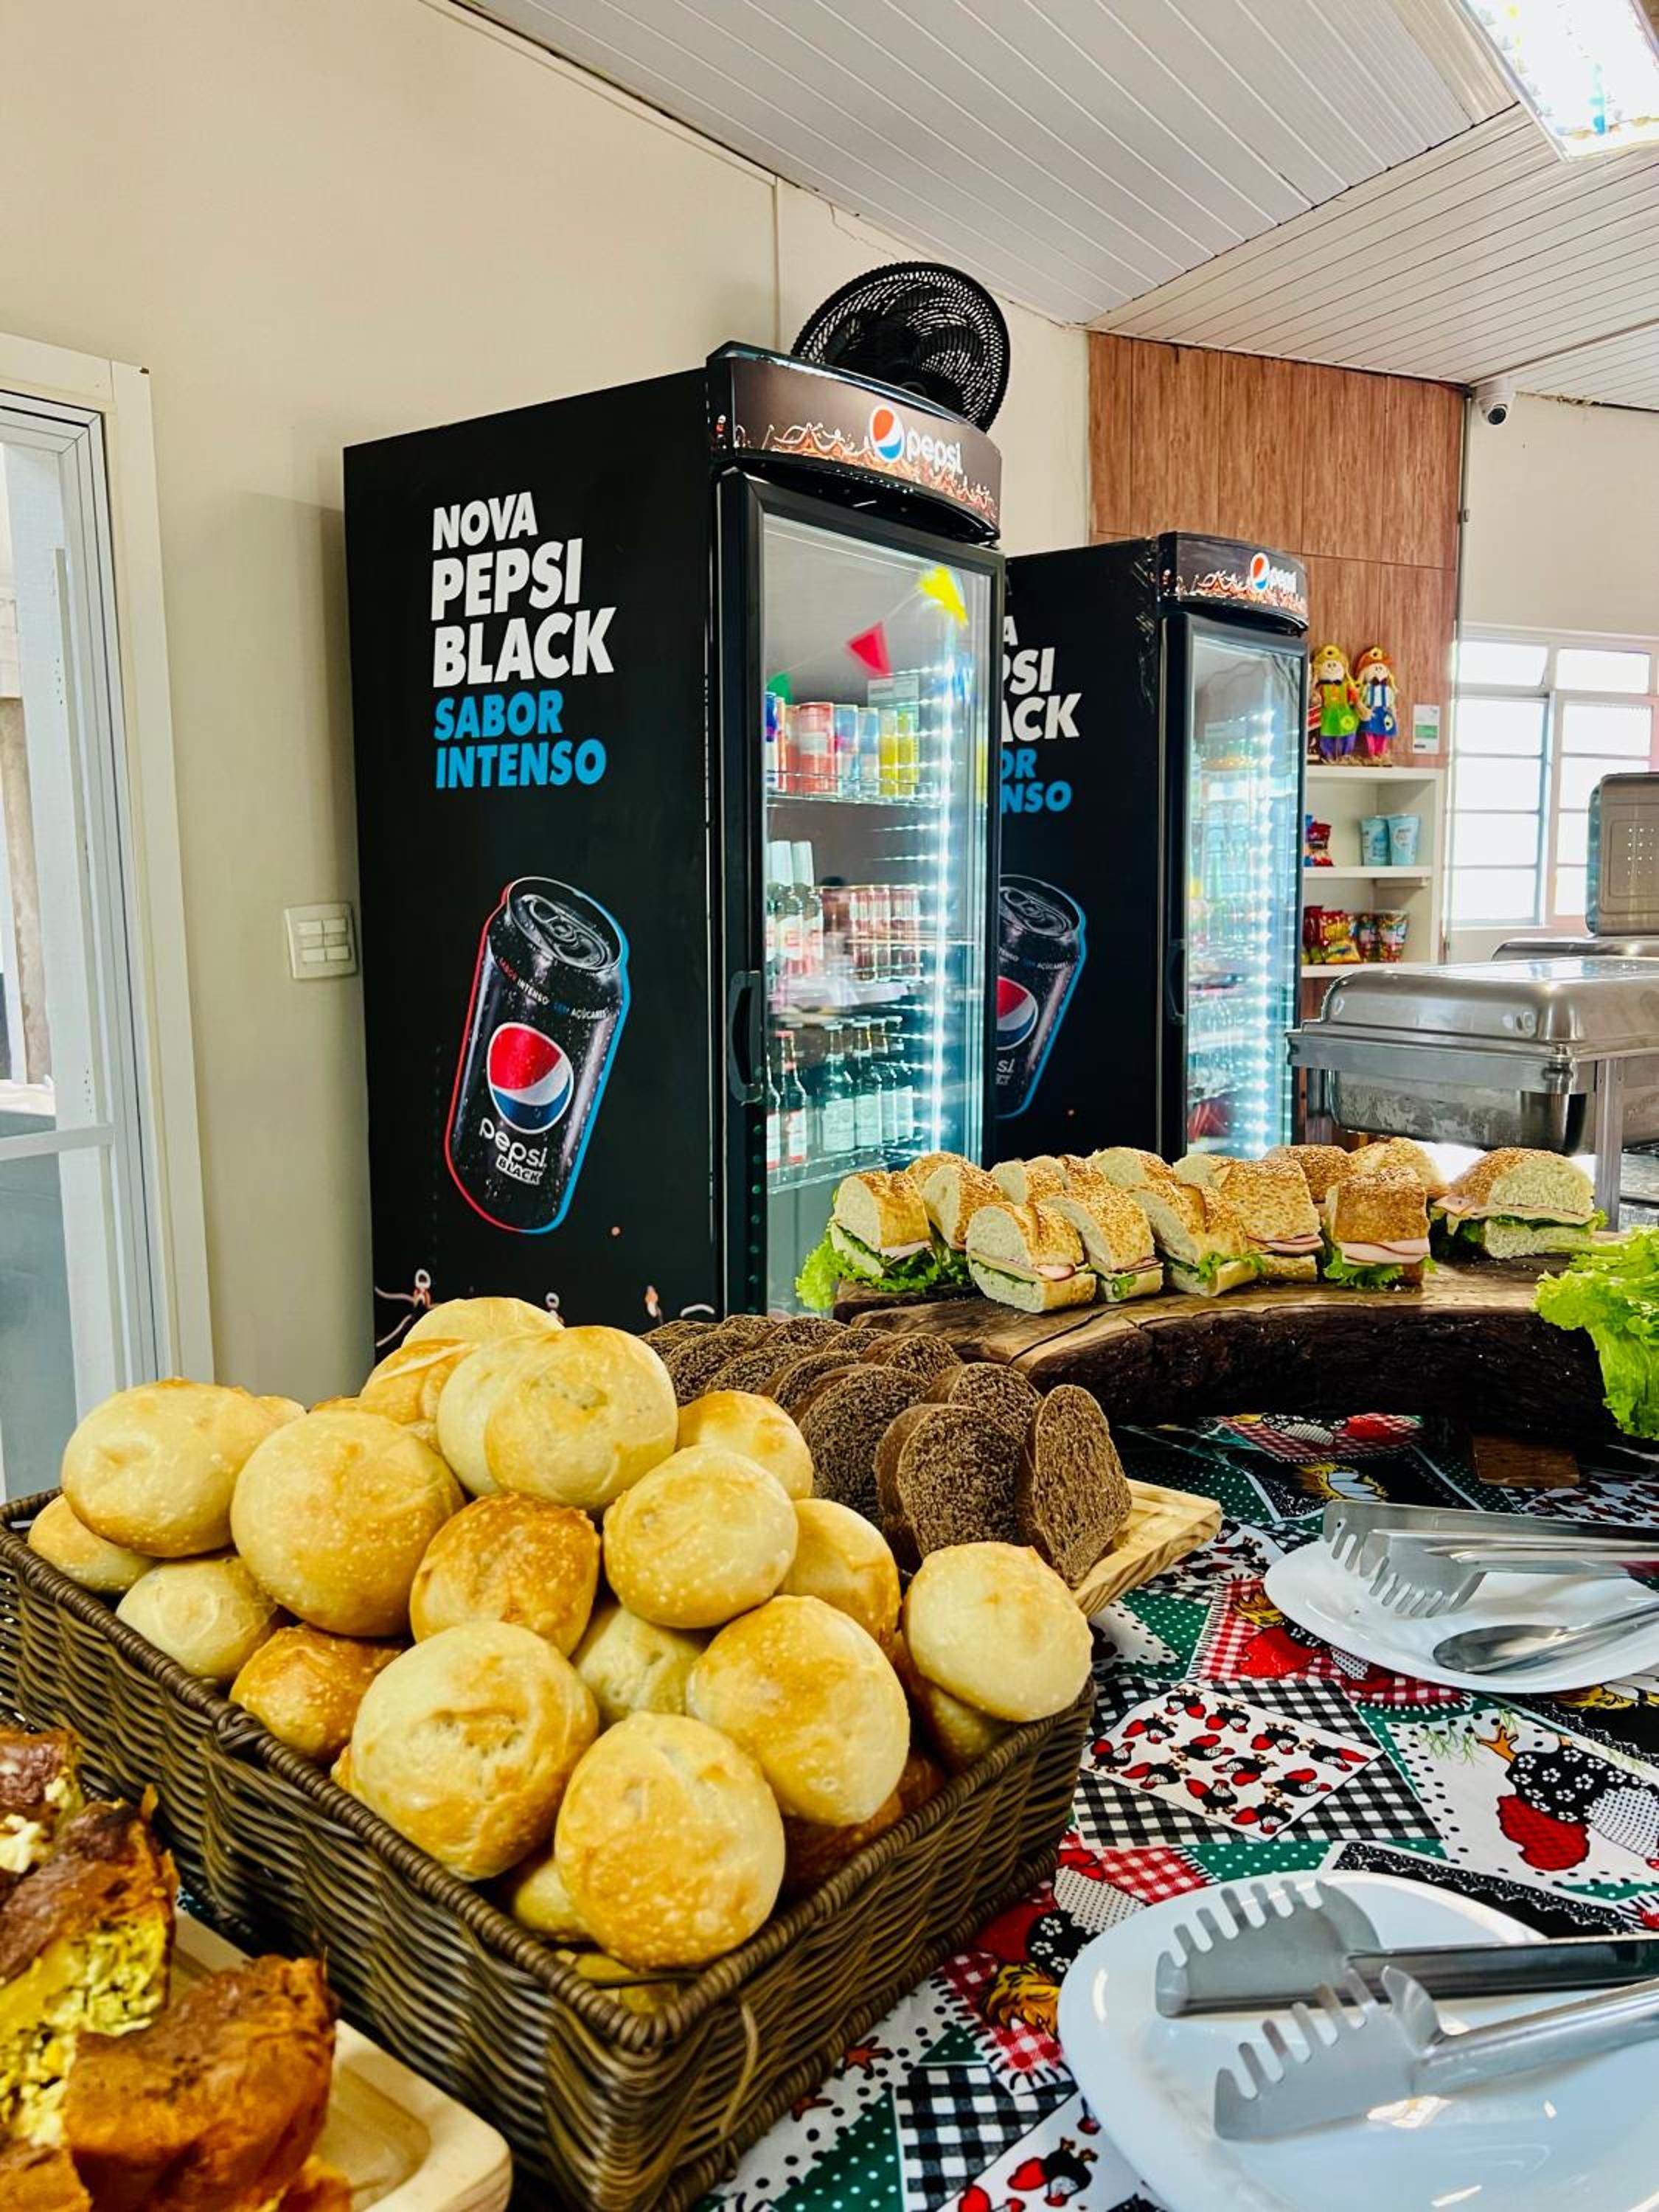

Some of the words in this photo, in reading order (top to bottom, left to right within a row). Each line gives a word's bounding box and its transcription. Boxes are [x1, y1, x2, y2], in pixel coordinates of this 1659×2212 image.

[907, 431, 963, 474] pepsi
[432, 491, 538, 551] NOVA
[431, 538, 583, 621] PEPSI
[433, 607, 617, 687] BLACK
[434, 689, 564, 741] SABOR
[436, 739, 607, 788] INTENSO
[517, 978, 549, 1005] INTENSO
[479, 1118, 548, 1167] pepsi
[496, 1155, 542, 1183] BLACK
